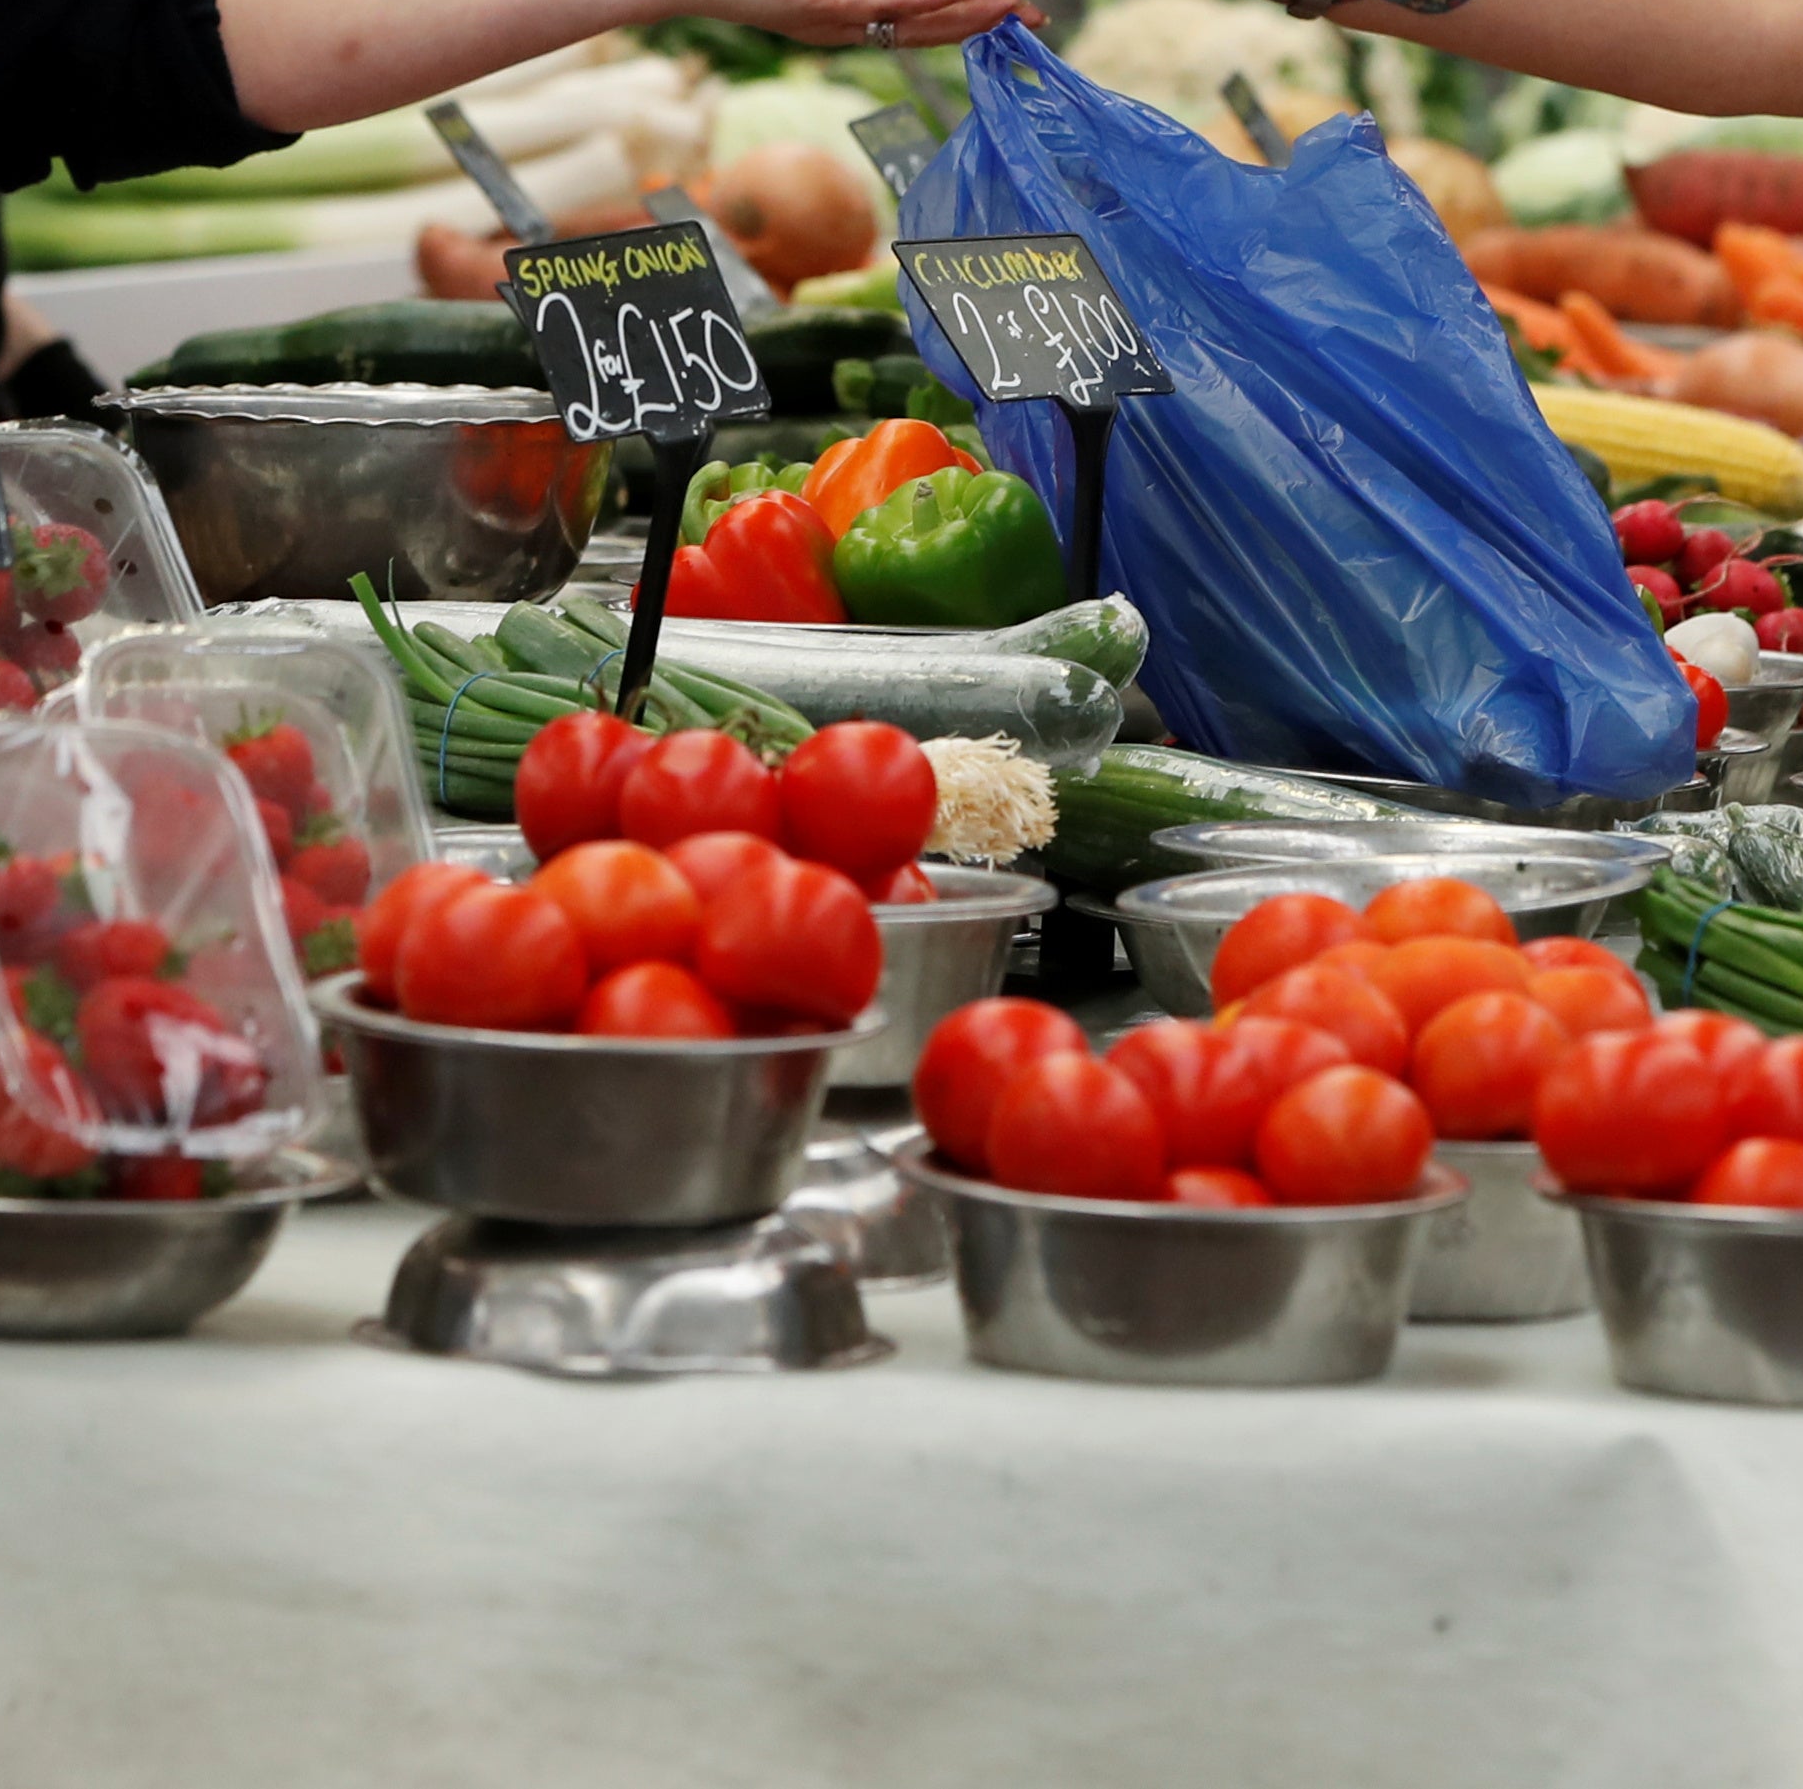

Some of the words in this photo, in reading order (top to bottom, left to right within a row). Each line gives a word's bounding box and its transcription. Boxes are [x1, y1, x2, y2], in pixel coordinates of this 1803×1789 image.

[518, 250, 620, 299] SPRING
[624, 237, 707, 280] ONION
[536, 292, 633, 439] 2
[617, 302, 758, 430] £1.50
[953, 292, 1021, 390] 2
